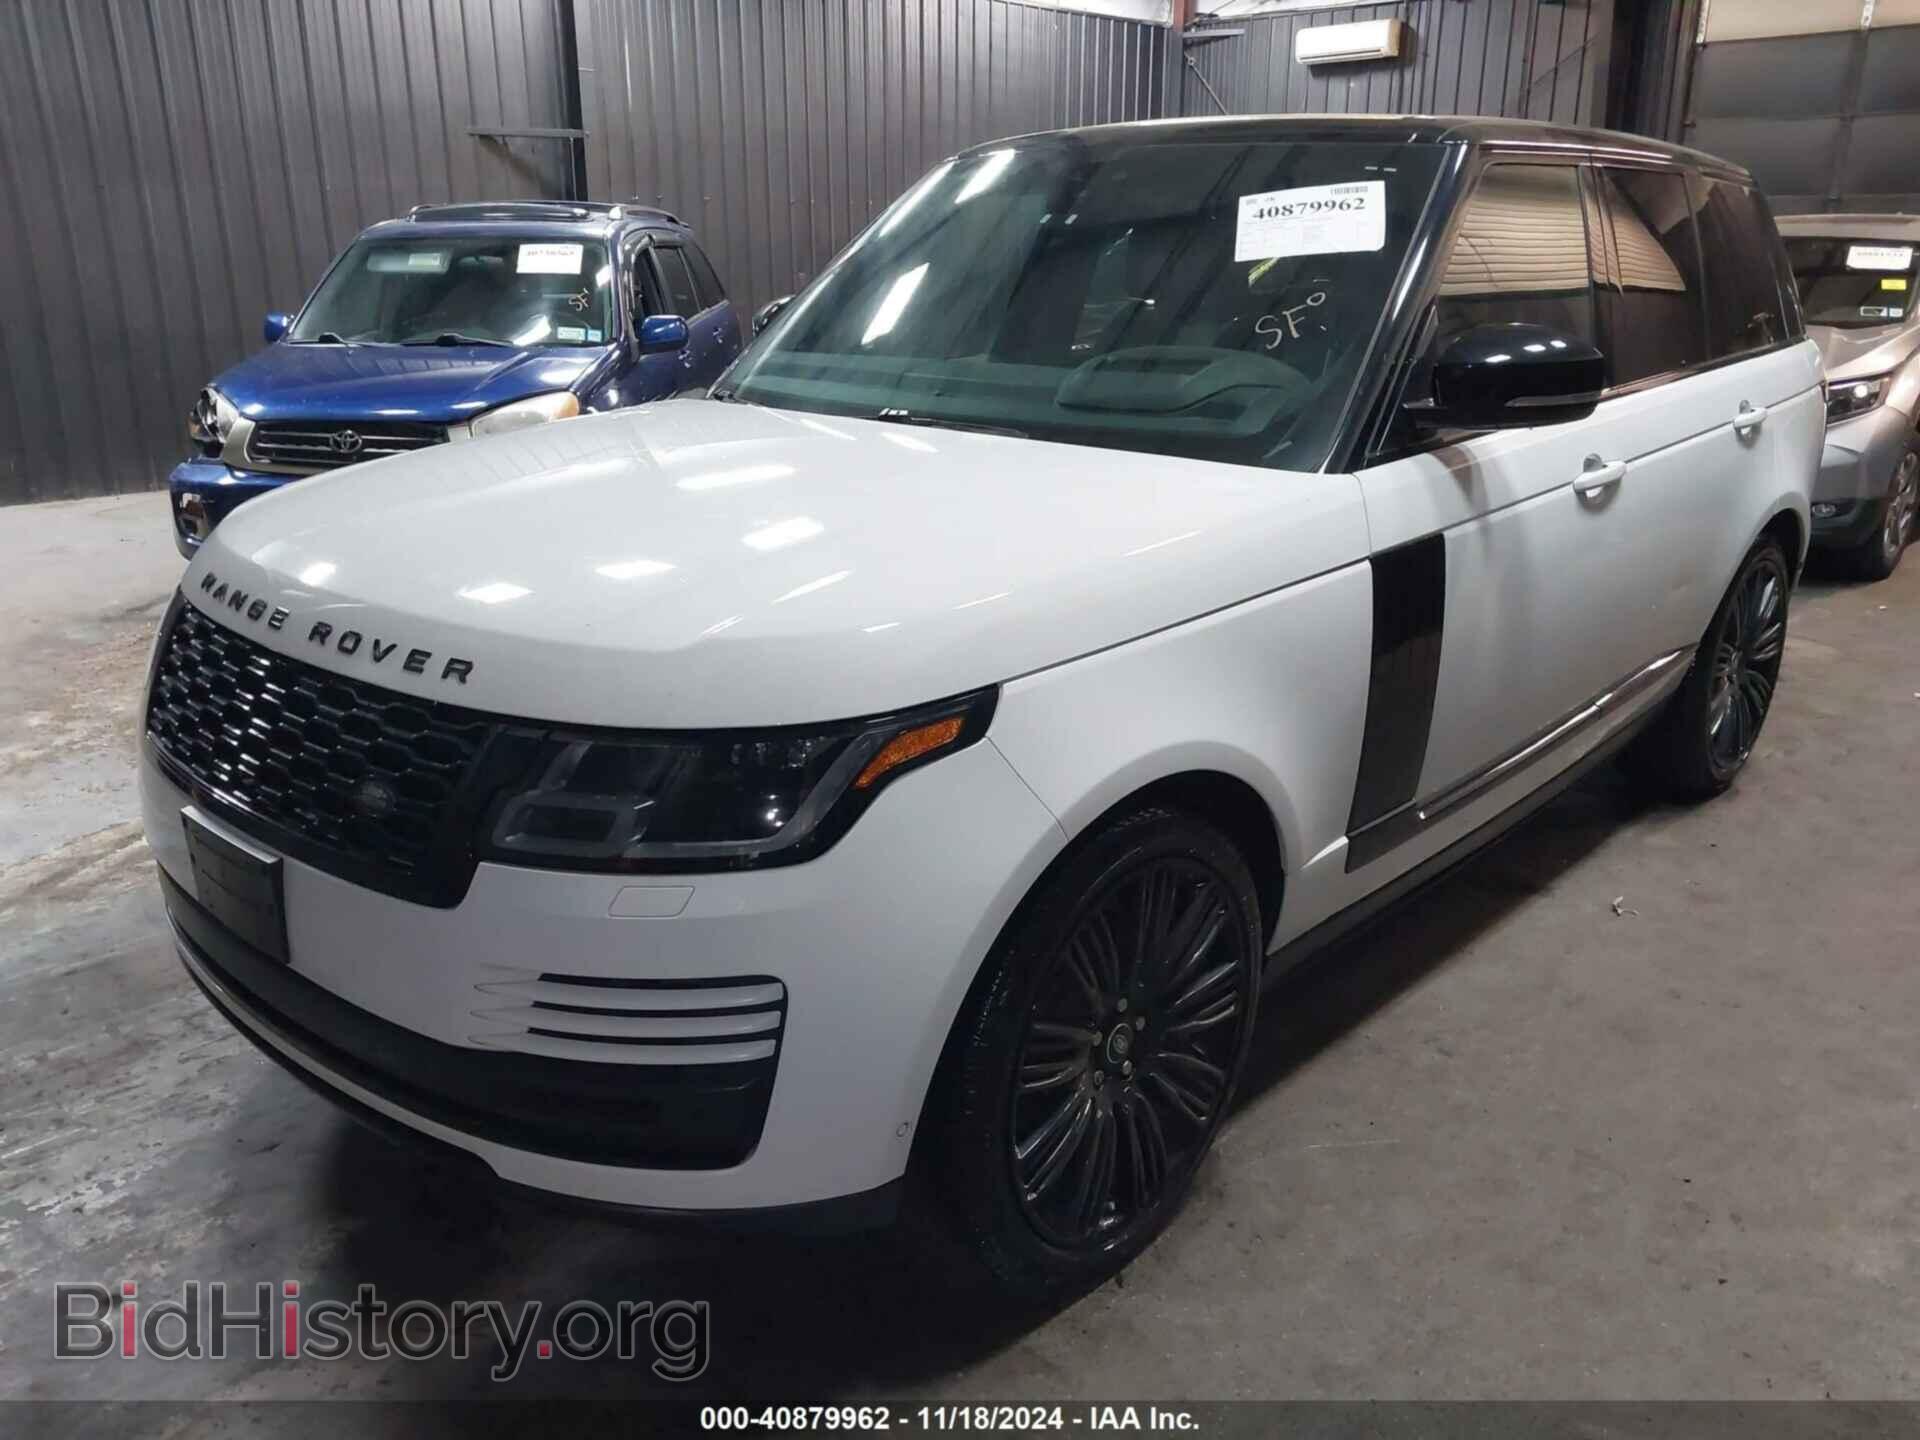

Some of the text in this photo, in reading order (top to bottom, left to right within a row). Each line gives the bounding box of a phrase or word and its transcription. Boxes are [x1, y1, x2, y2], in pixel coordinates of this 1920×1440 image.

[1252, 197, 1366, 219] 40879962
[200, 571, 474, 685] RANGE ROVER
